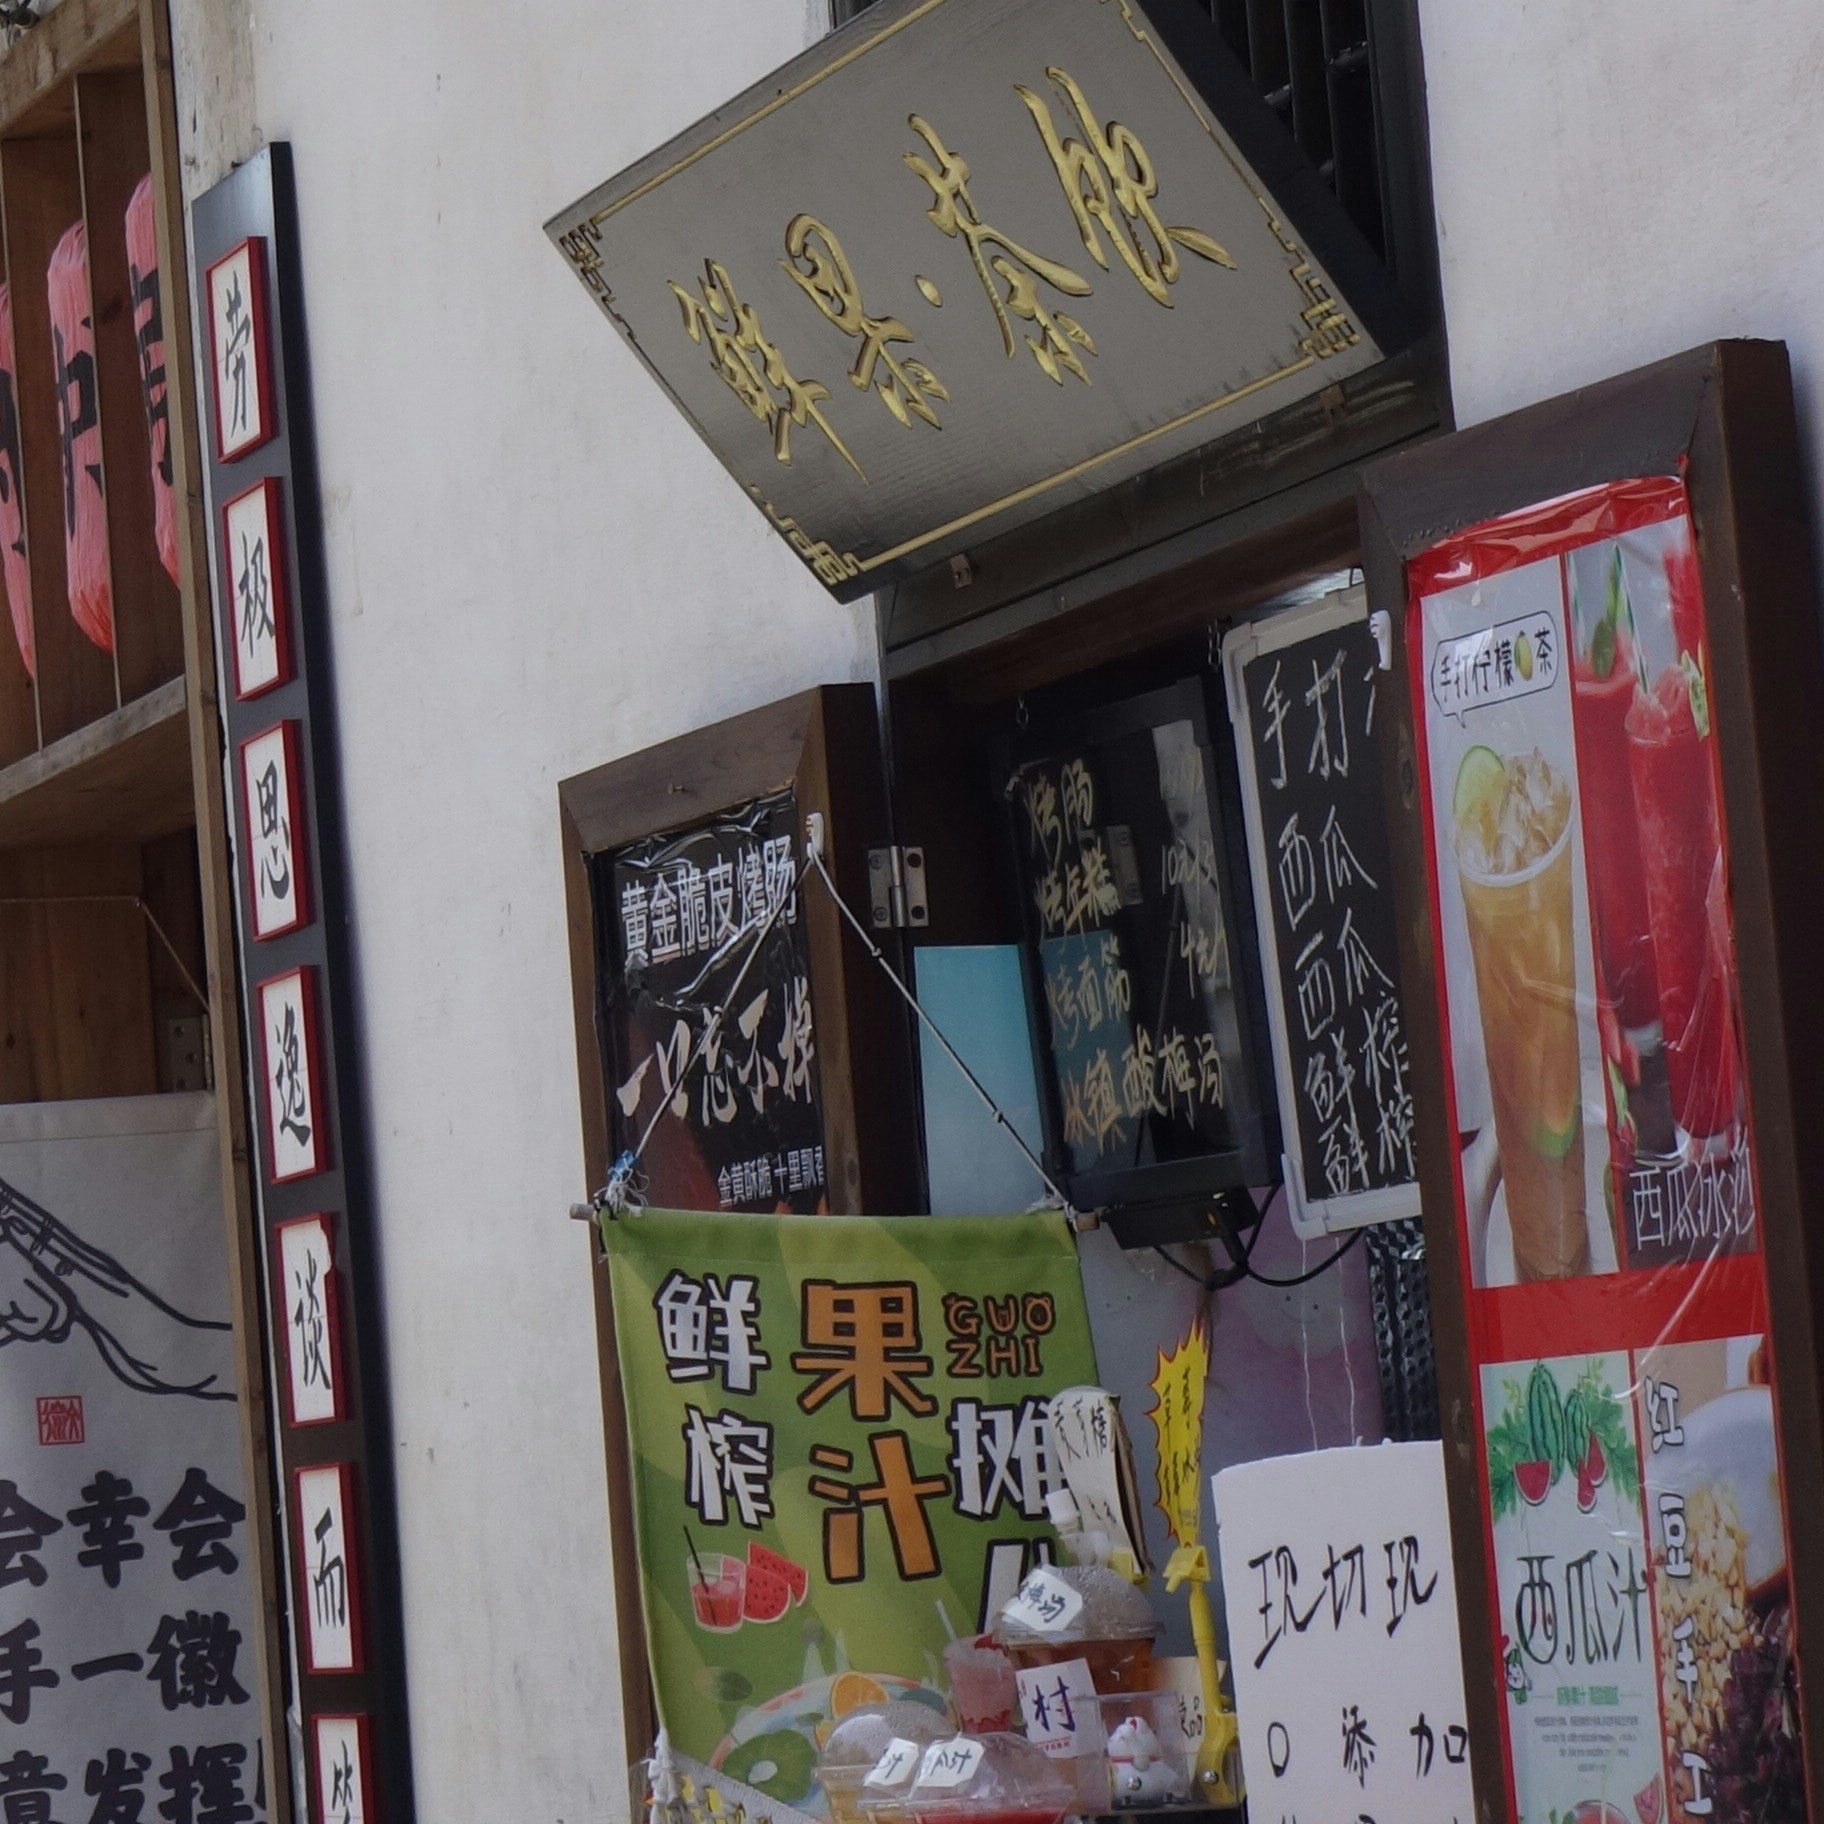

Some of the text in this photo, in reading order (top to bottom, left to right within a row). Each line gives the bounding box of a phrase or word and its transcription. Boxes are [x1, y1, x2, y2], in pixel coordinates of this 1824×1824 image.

[944, 1292, 1056, 1336] GUO
[948, 1336, 1046, 1378] ZHI
[1248, 1535, 1439, 1670] 现切现
[1515, 1546, 1649, 1666] 西瓜汁
